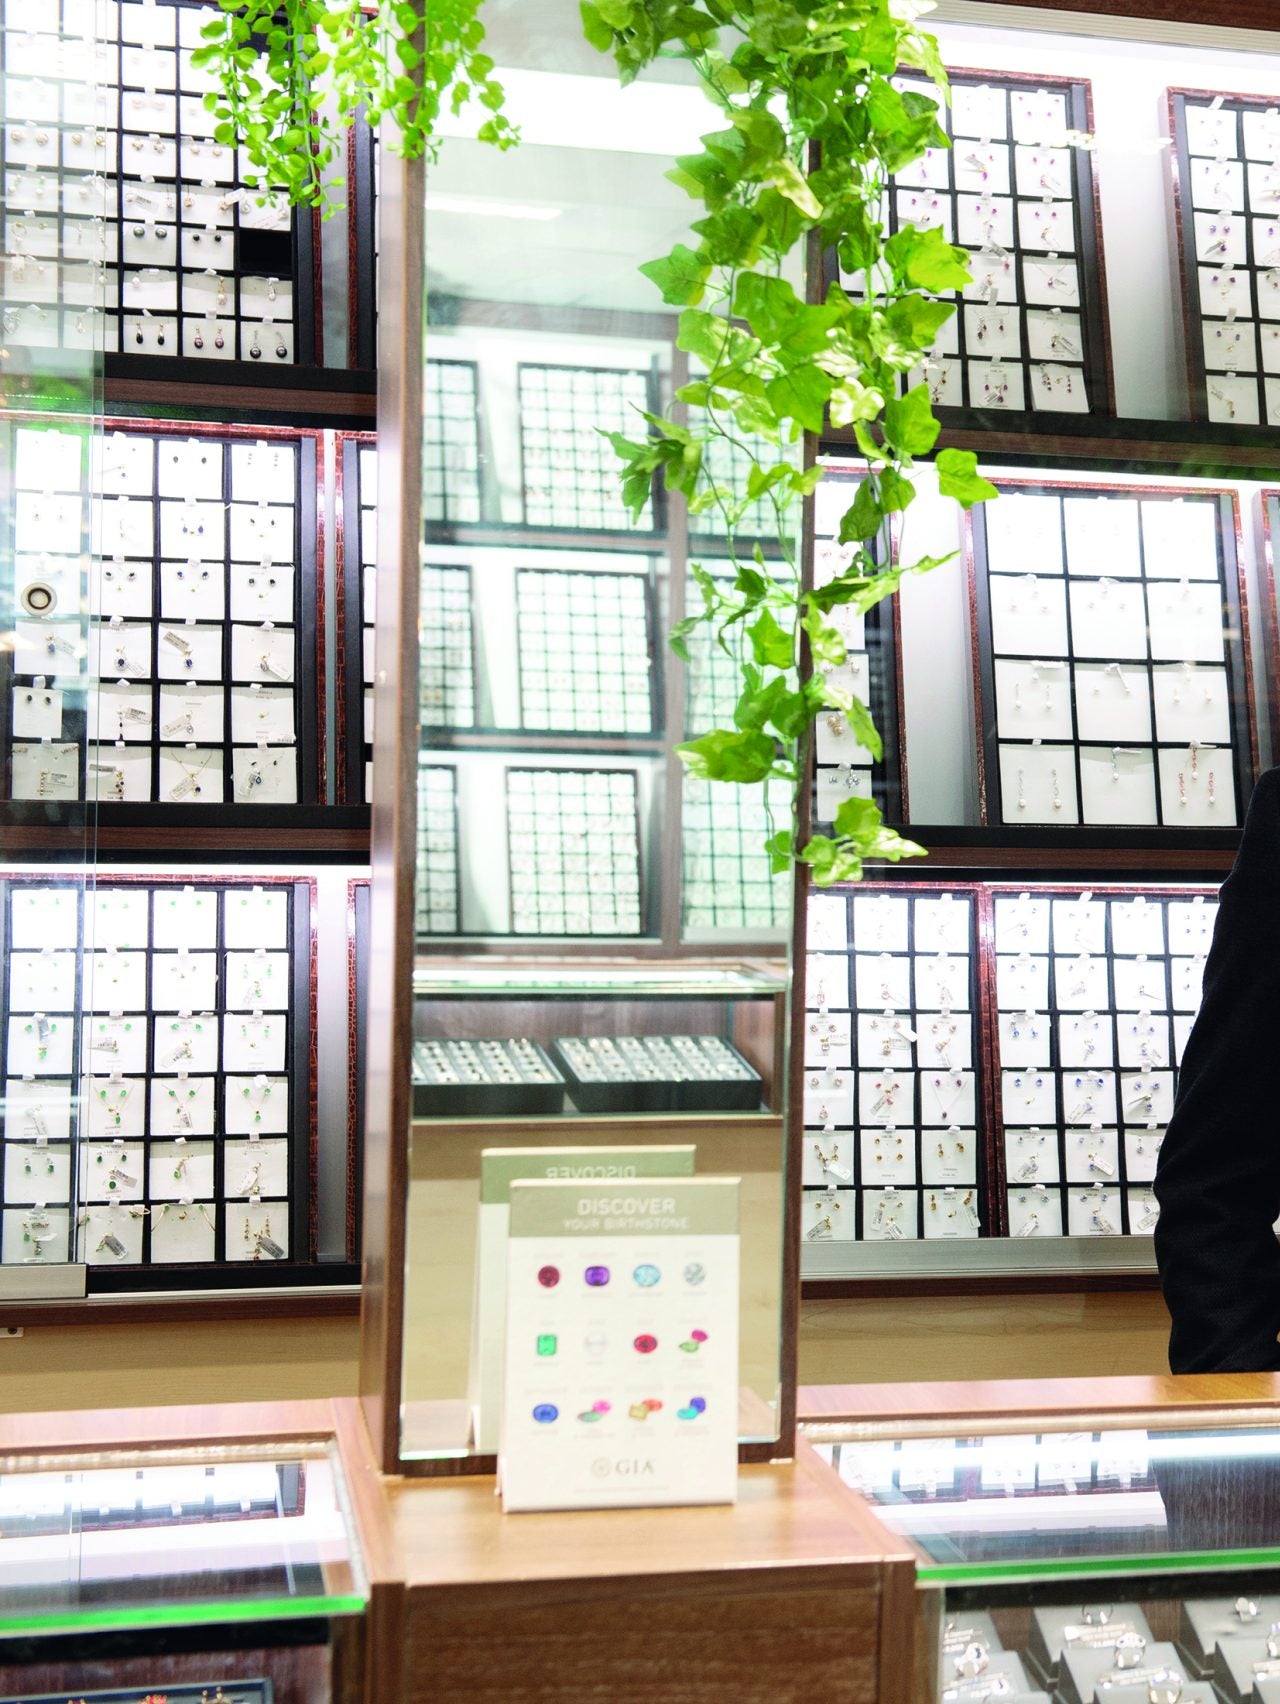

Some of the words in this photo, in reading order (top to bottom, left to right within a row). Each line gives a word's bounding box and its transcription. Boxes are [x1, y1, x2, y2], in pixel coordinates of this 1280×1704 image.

[577, 1198, 676, 1216] DISCOVER
[563, 1219, 600, 1231] YOUR
[604, 1217, 689, 1231] BIRTHSTONE
[615, 1458, 656, 1476] GIA
